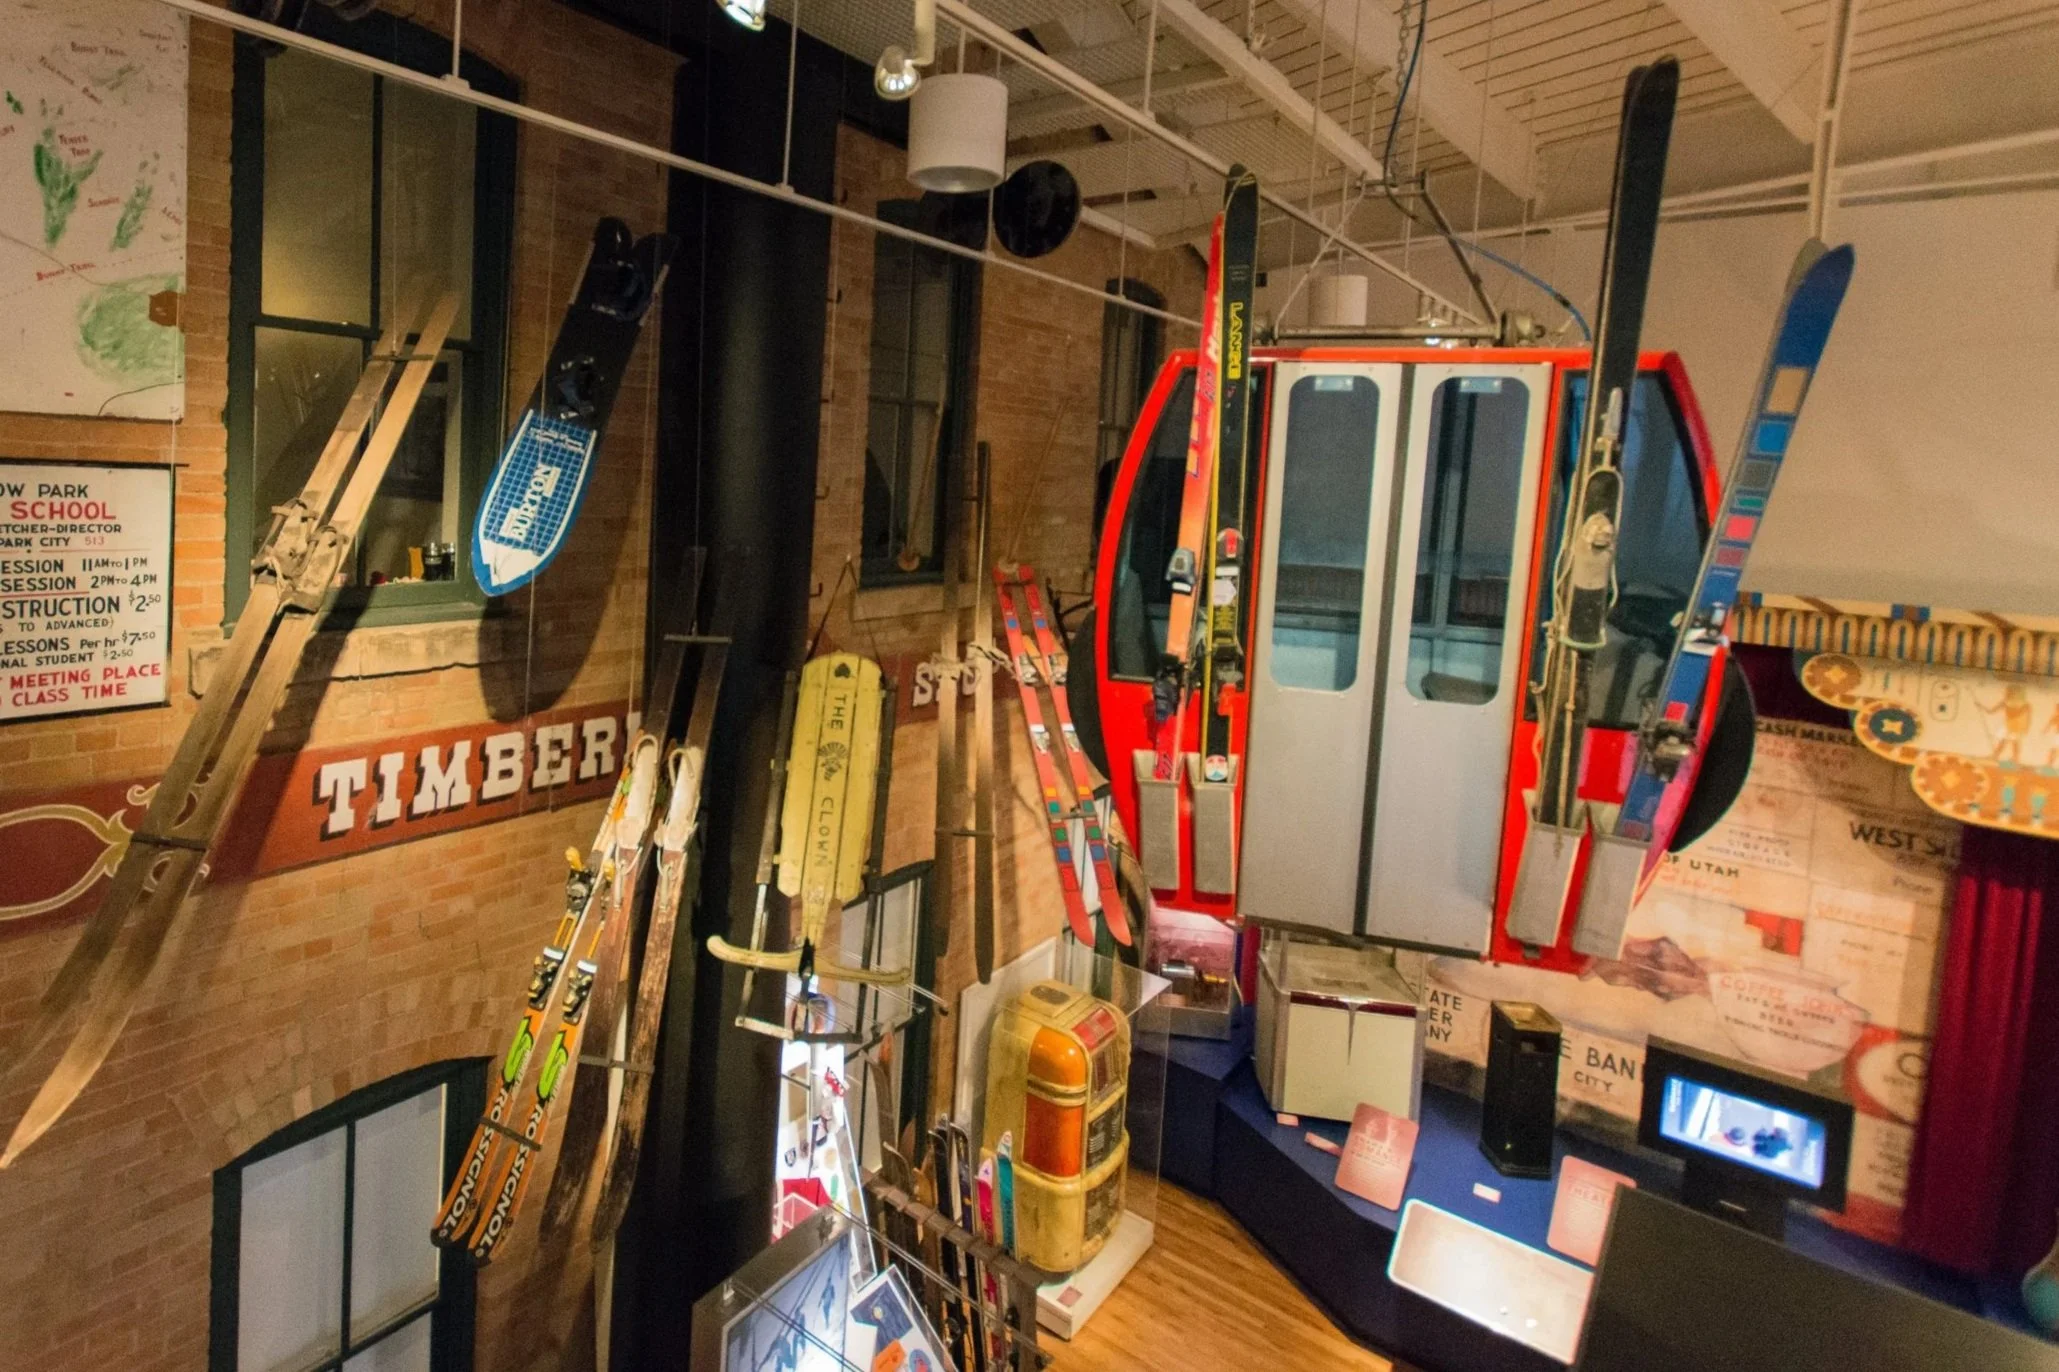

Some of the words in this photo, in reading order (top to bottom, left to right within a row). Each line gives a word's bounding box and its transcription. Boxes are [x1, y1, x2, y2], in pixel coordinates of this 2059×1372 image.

[38, 484, 89, 498] PARK
[512, 463, 552, 542] BURTON
[11, 501, 117, 521] SCHOOL
[40, 536, 71, 547] CITY
[84, 536, 105, 546] 513
[1, 576, 77, 593] SESSION
[2, 596, 121, 620] STRUCTION
[18, 622, 36, 632] TO
[46, 618, 115, 632] ADVANCED)
[80, 639, 102, 649] Per
[104, 637, 119, 648] hr
[35, 652, 95, 666] STUDENT
[10, 668, 91, 690] MEETING
[102, 663, 161, 682] PLACE
[12, 687, 70, 707] CLASS
[82, 682, 128, 699] TIME
[831, 694, 848, 731] THE
[814, 796, 835, 868] CLOWN
[1849, 820, 1917, 850] WEST
[1690, 861, 1740, 878] UTAH
[1586, 1046, 1636, 1080] BAN
[1574, 1071, 1613, 1092] CITY
[444, 1087, 509, 1229] ROSSIGNOL
[480, 1103, 545, 1249] ROSSIGNOL
